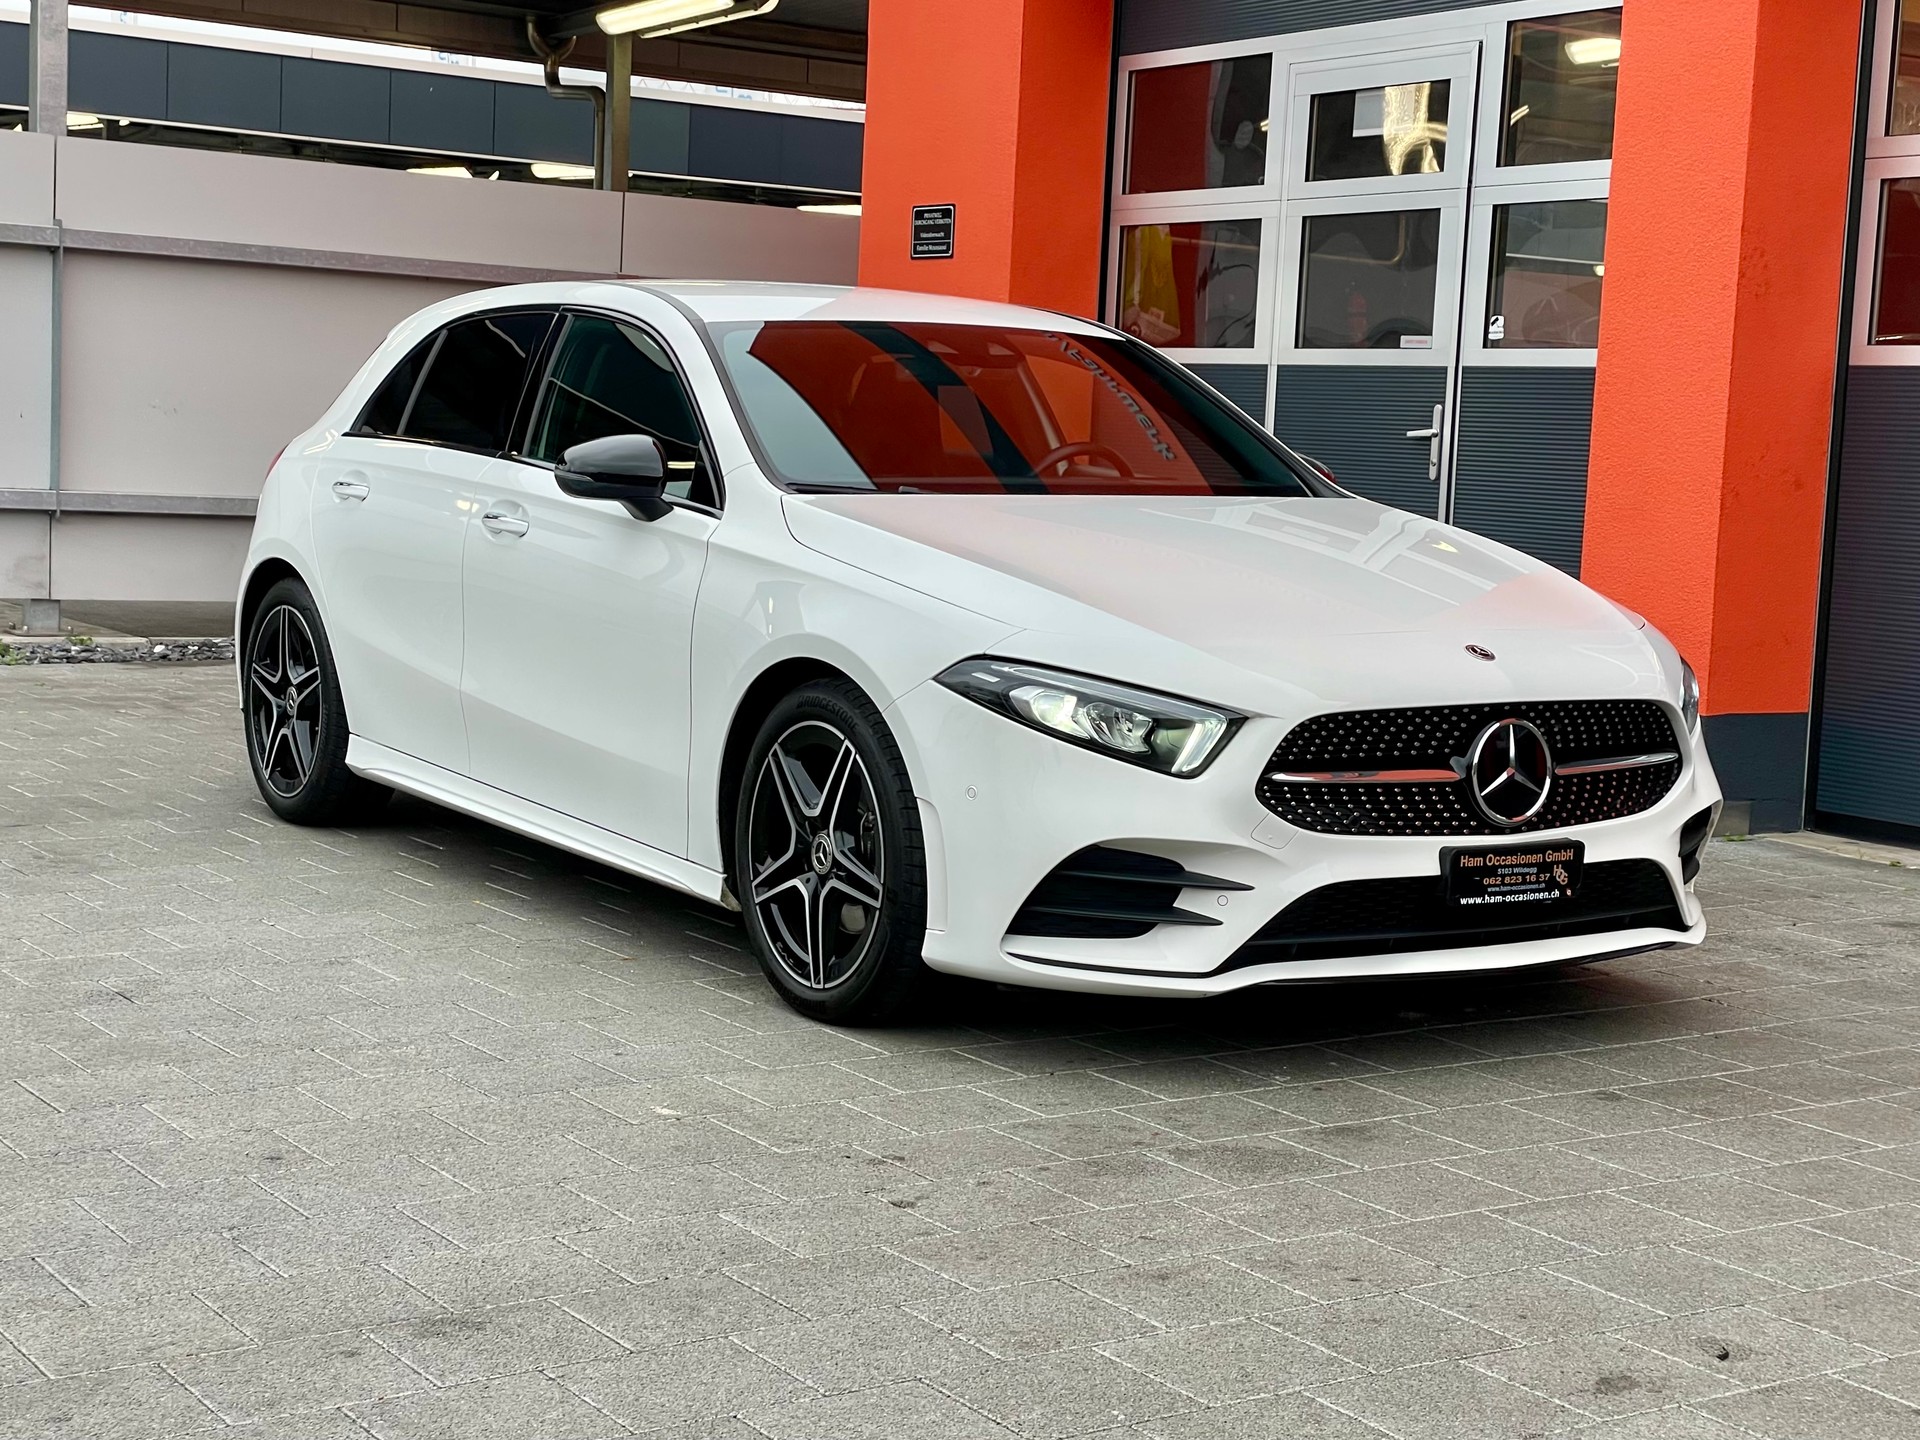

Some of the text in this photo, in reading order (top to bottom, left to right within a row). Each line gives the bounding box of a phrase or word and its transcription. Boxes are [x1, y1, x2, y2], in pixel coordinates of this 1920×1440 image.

[796, 695, 860, 730] BRIDGESTONE
[1460, 848, 1574, 868] Ham Occasionen GmbH
[1483, 877, 1502, 885] 062
[1487, 883, 1545, 892] www.ham-occasionen.ch
[1460, 889, 1560, 904] www.ham-occasionen.ch
